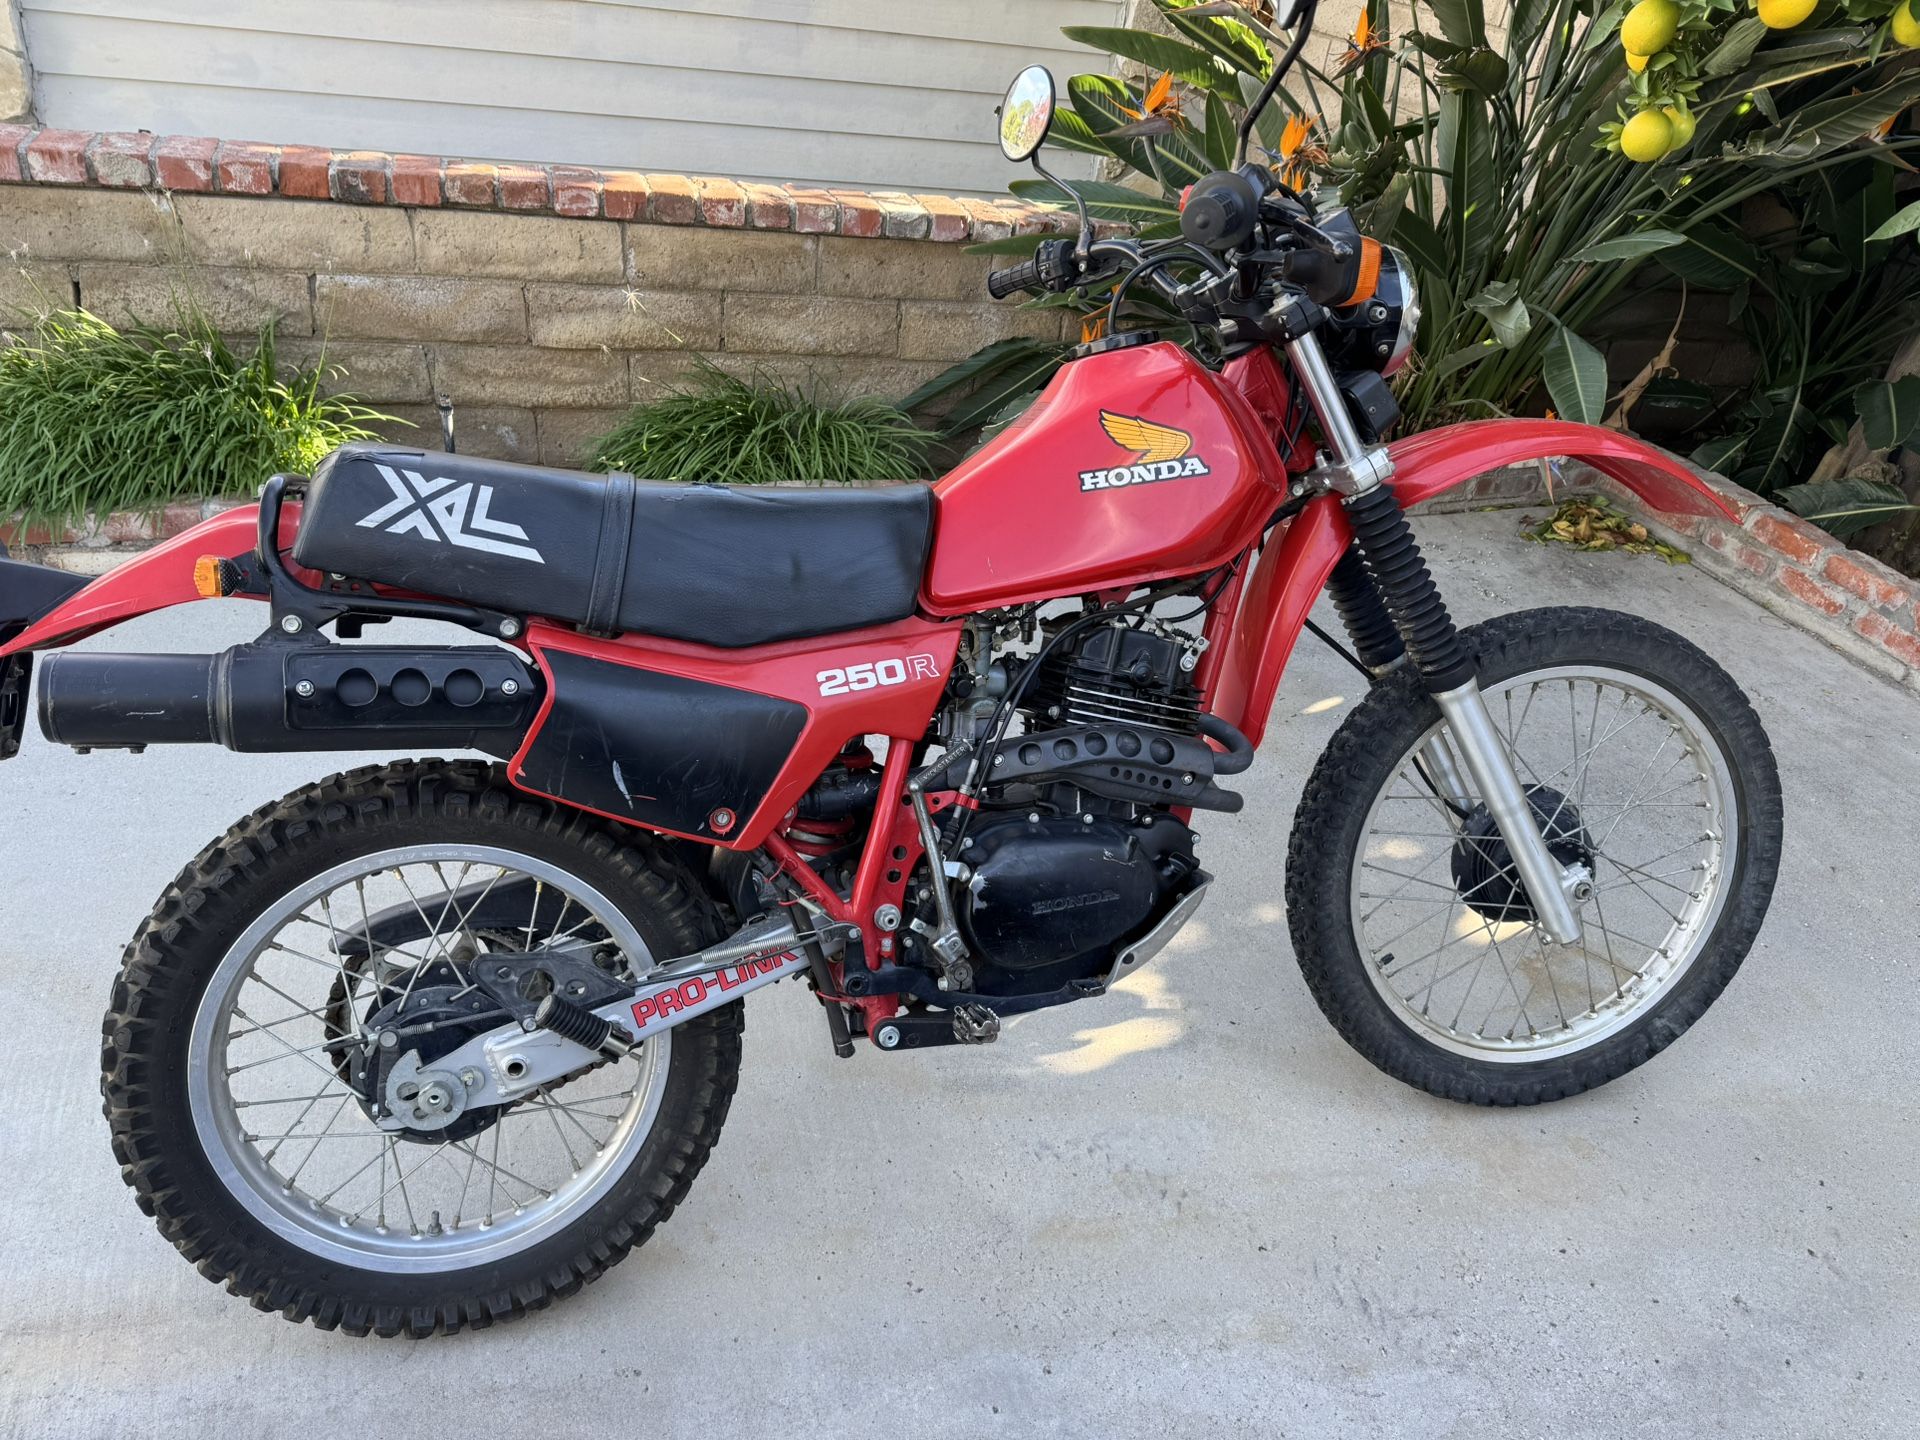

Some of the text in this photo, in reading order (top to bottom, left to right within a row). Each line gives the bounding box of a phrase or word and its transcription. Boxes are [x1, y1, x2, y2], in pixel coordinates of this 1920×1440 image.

[1079, 456, 1210, 491] HONDA
[1031, 889, 1121, 915] HONDA
[630, 945, 799, 1029] PRO-LINK
